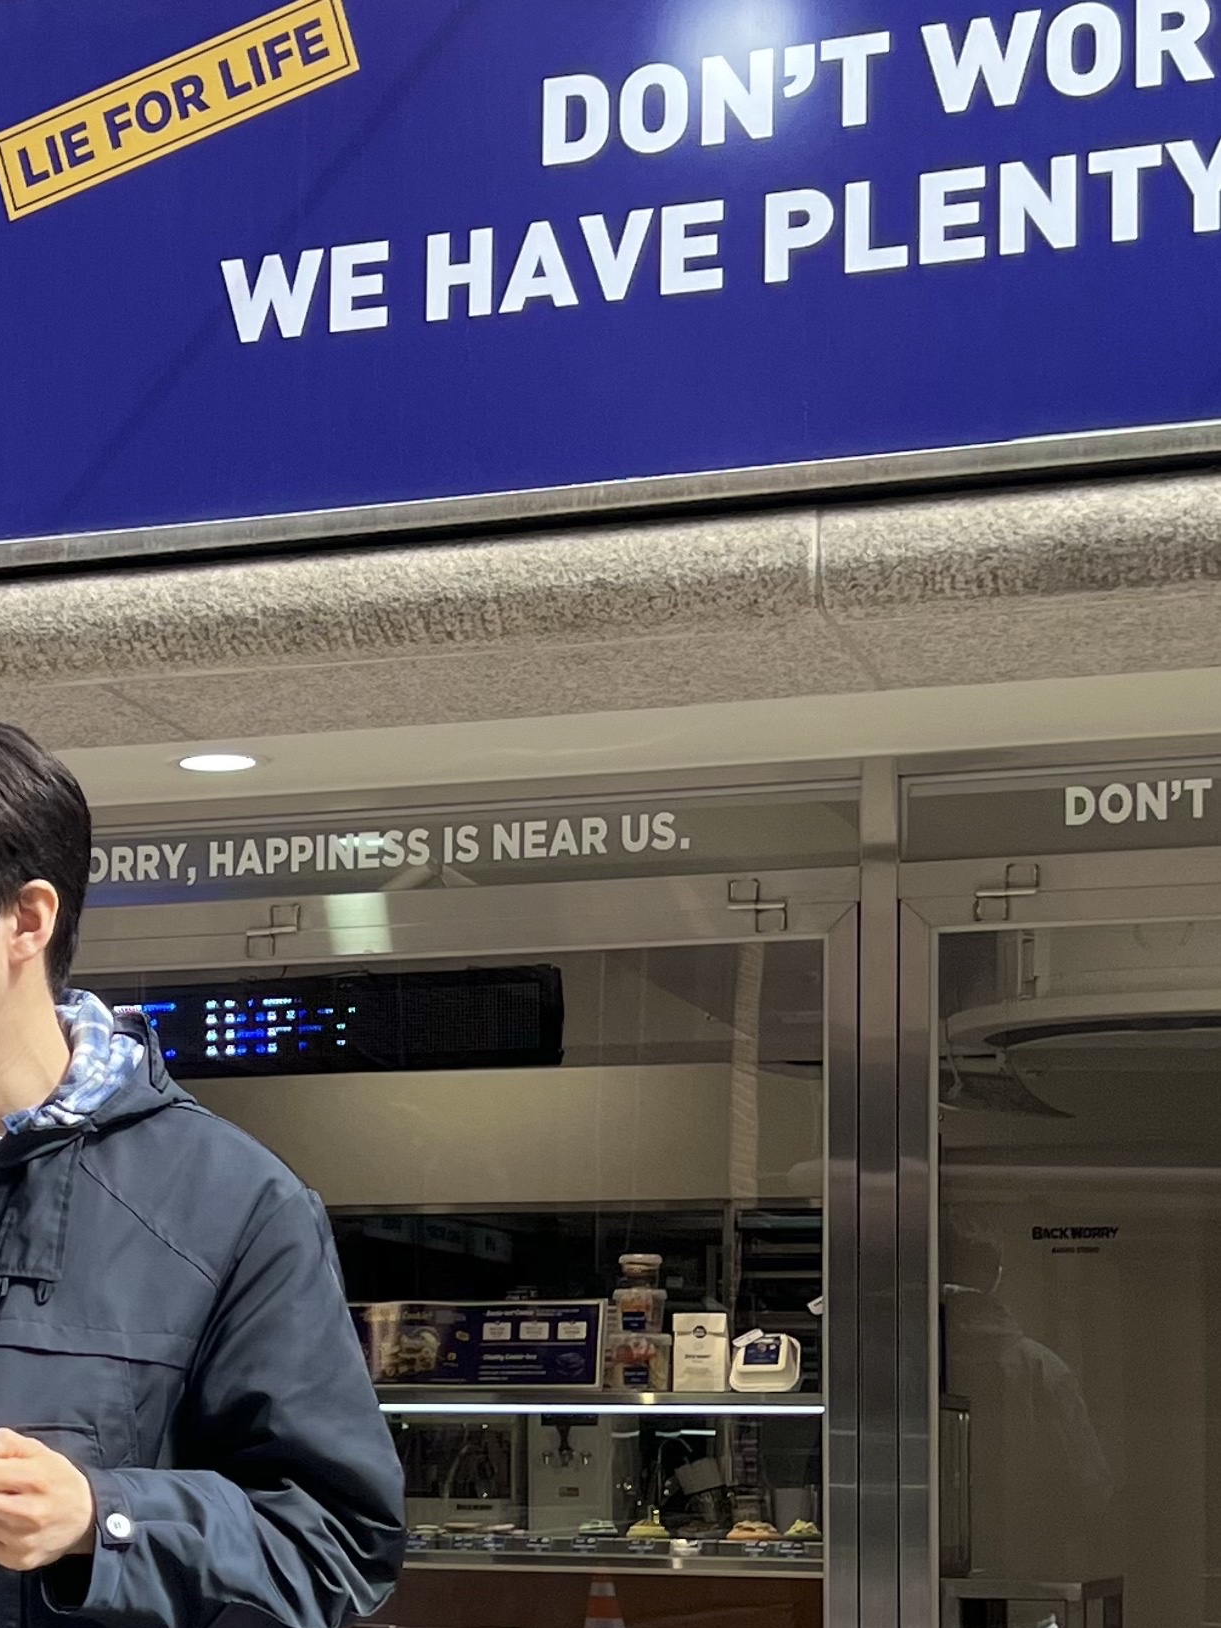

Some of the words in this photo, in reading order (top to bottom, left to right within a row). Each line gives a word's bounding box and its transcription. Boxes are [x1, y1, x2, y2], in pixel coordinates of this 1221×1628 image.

[16, 121, 95, 188] LIE
[102, 74, 210, 150] FOR
[218, 17, 330, 100] LIFE
[541, 31, 890, 166] DON'T
[221, 237, 389, 343] WE
[425, 199, 724, 321] HAVE
[764, 138, 1221, 284] PLENTY
[208, 829, 430, 878] HAPPINESS
[444, 825, 480, 865] IS
[492, 817, 608, 861] NEAR
[621, 812, 691, 852] US.
[1065, 778, 1213, 826] DON'T
